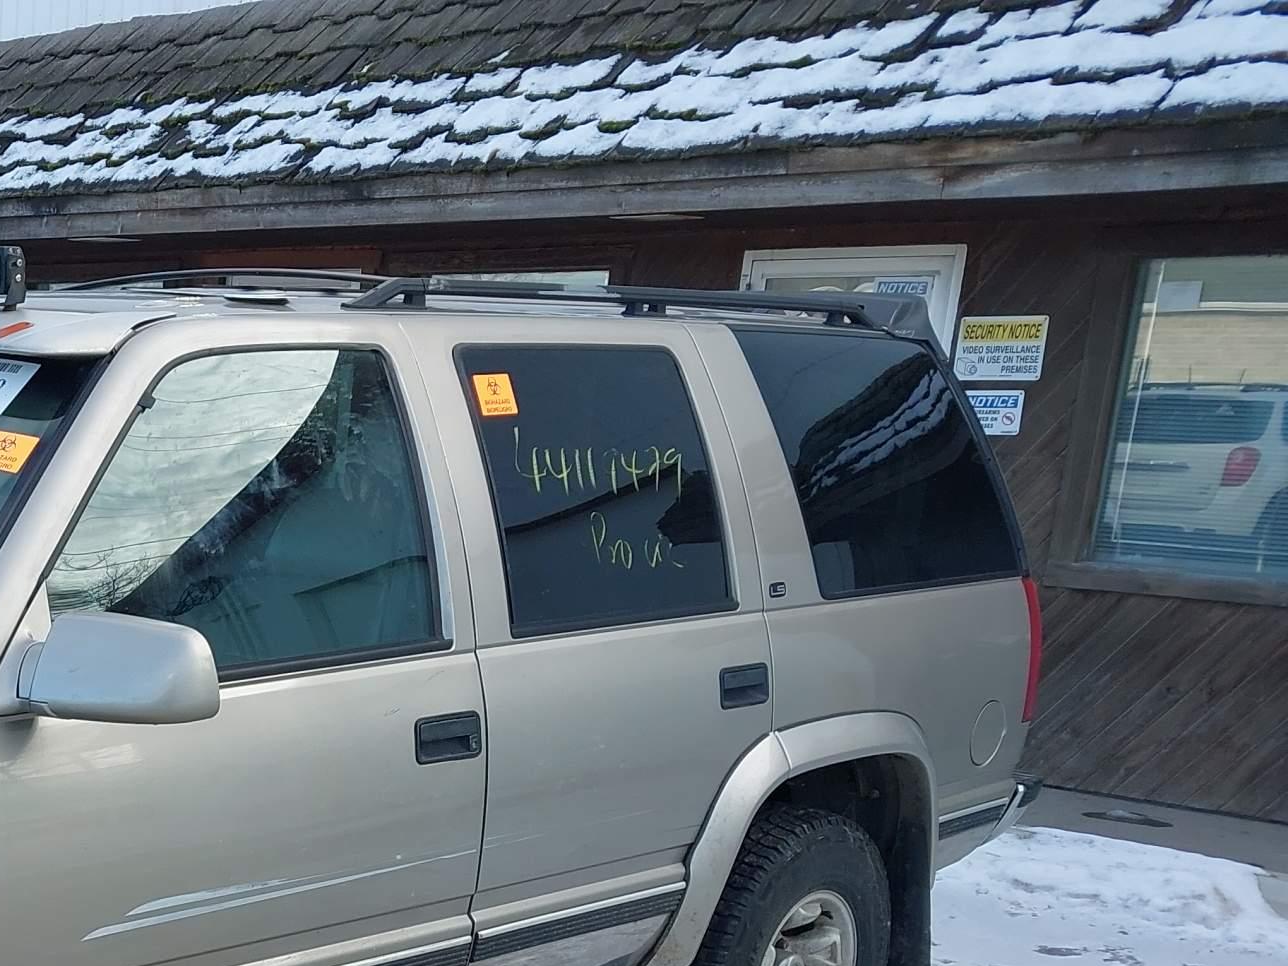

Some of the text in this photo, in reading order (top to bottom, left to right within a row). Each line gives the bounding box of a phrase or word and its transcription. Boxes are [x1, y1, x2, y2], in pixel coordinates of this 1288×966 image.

[877, 281, 927, 295] NOTICE
[963, 323, 1043, 340] SECURITY NOTICE
[962, 344, 1041, 355] VIDEO SURVEILLANCE
[977, 355, 1040, 364] IN USE ON THESE
[1000, 365, 1039, 374] PREMISES
[770, 584, 786, 596] LS
